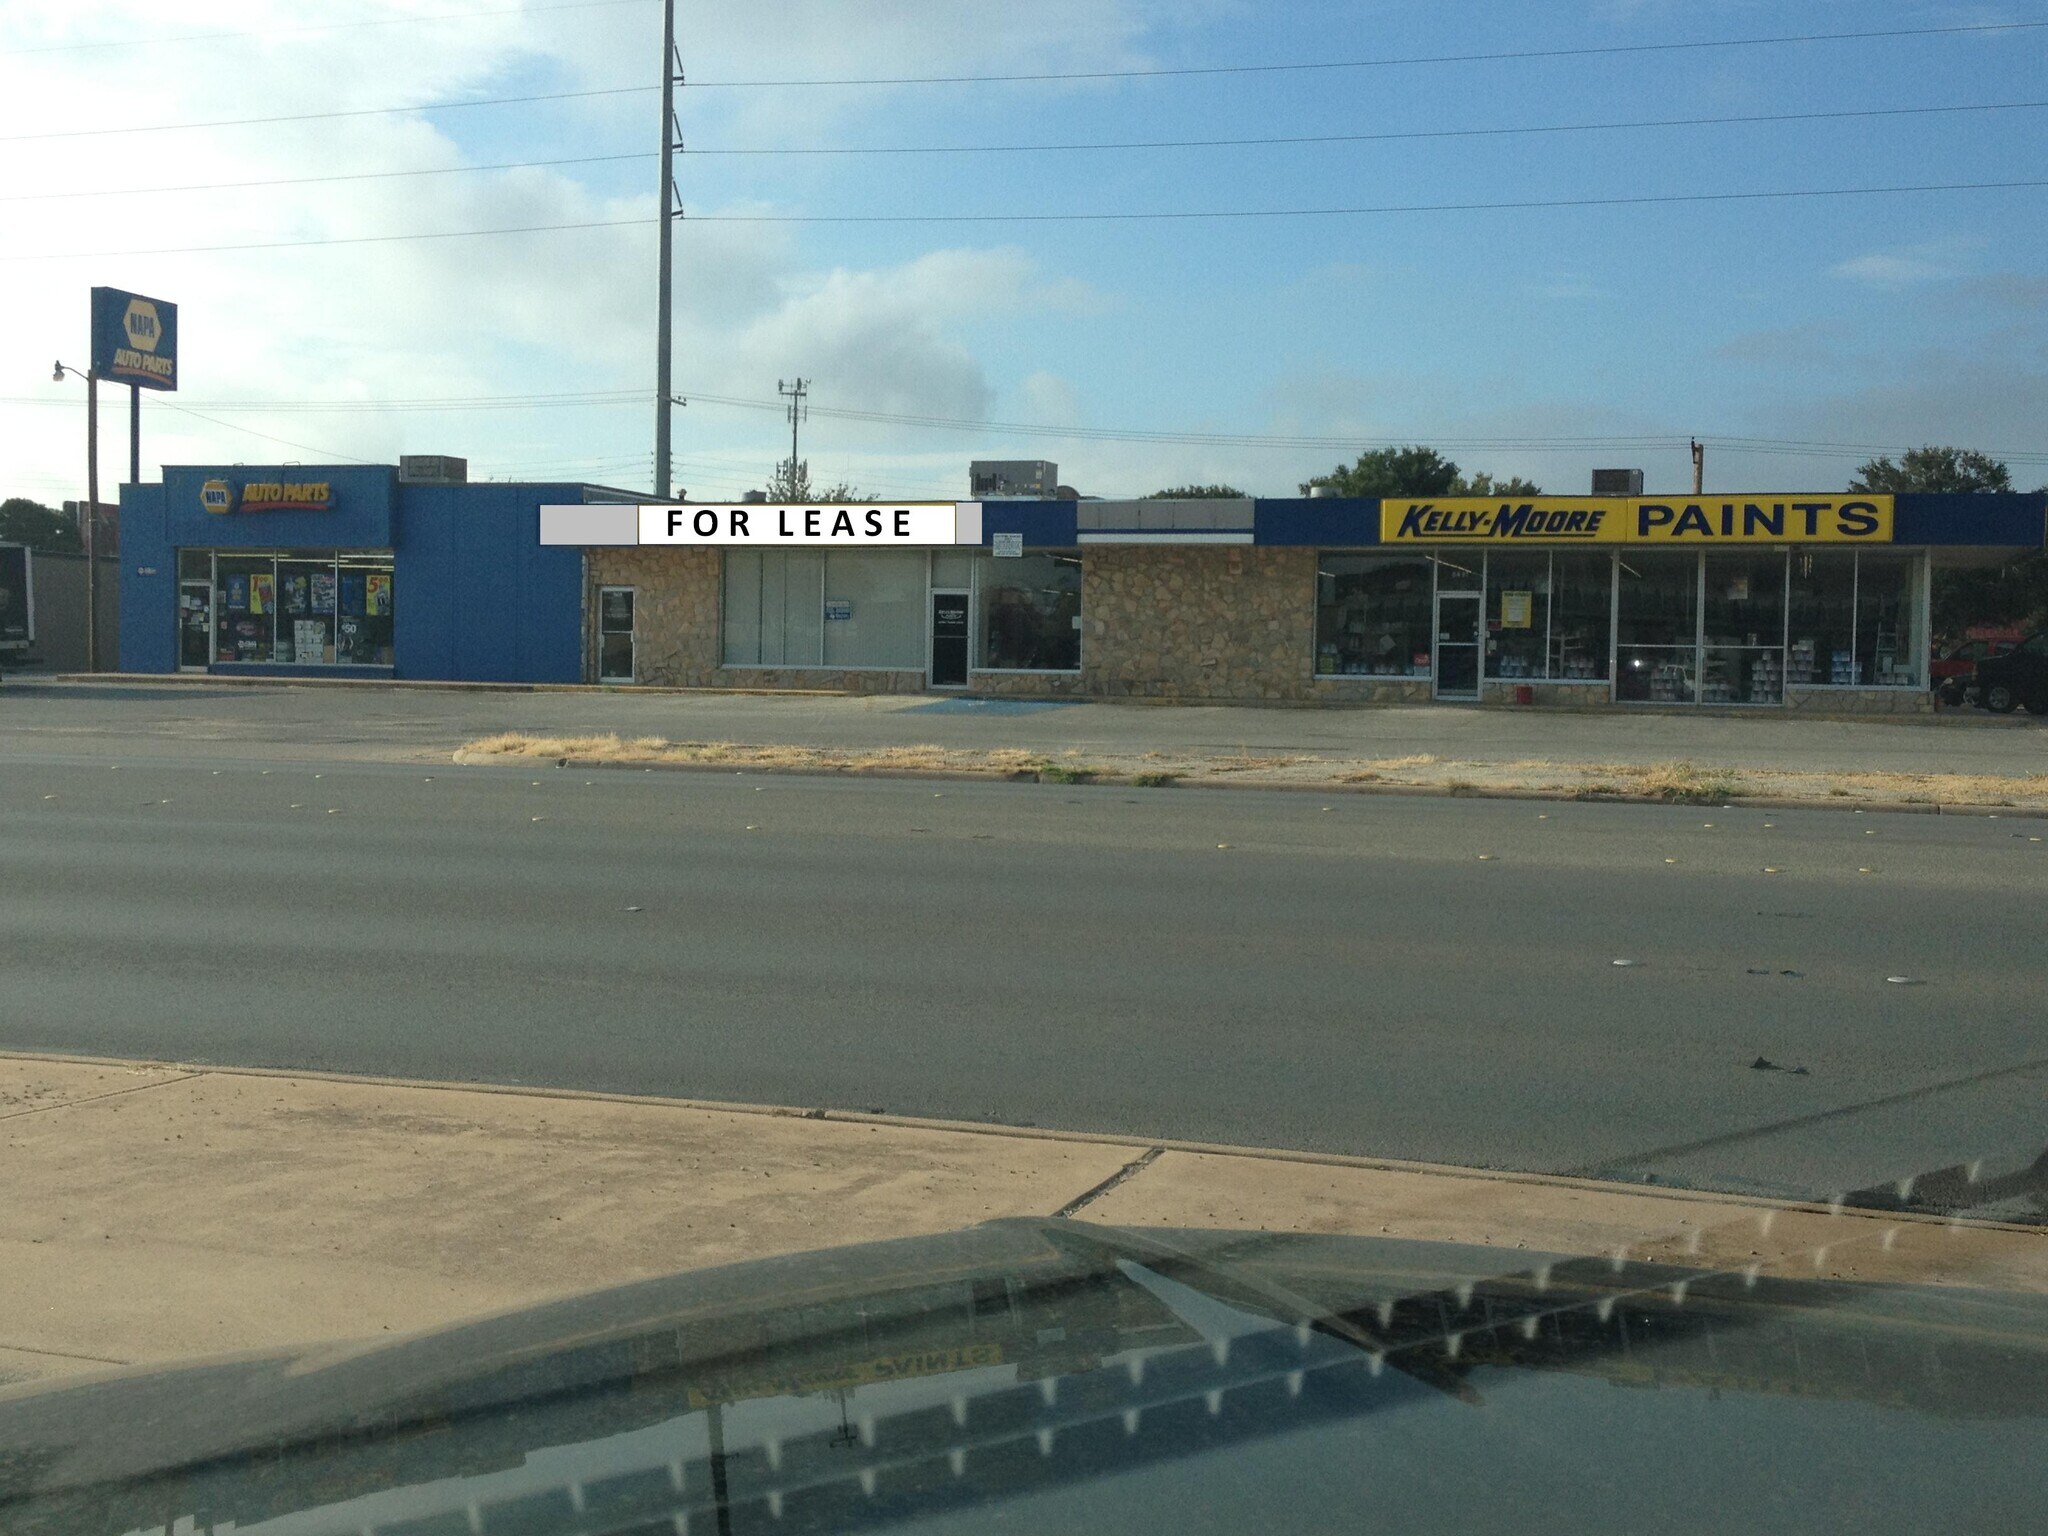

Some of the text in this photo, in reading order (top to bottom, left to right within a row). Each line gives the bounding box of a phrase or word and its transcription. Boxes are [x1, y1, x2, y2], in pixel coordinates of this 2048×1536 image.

[130, 313, 154, 338] NAPA
[113, 349, 173, 376] AUTO PARTS
[205, 490, 226, 505] NAPA
[243, 482, 330, 502] AUTO PARTS
[1396, 501, 1880, 538] KELLY-MOORE PAINTS
